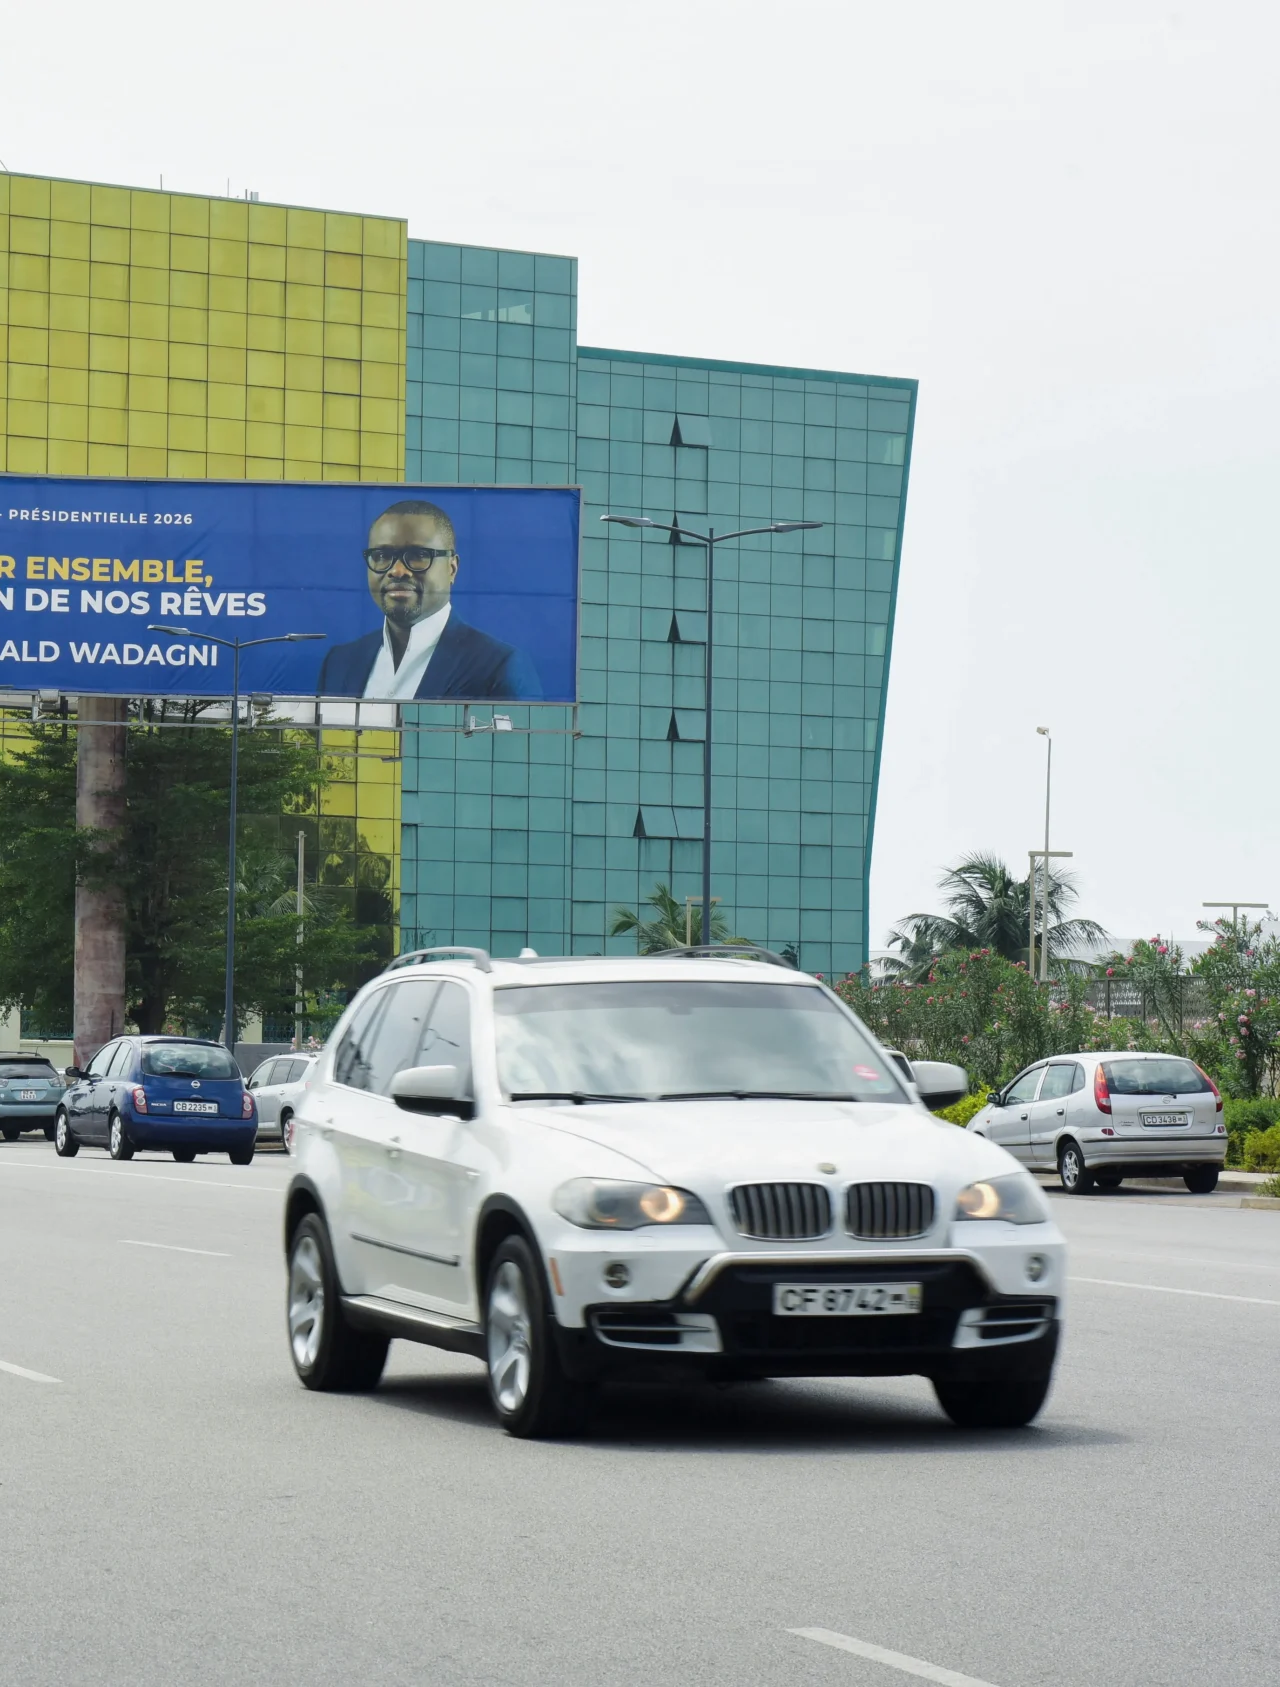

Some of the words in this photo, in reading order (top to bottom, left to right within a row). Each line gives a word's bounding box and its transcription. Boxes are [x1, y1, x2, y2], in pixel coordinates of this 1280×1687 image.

[9, 507, 148, 524] PRÉSIDENTIELLE
[153, 513, 193, 525] 2026
[26, 556, 213, 588] ENSEMBLE,
[25, 587, 70, 613] DE
[80, 589, 151, 615] NOS
[160, 586, 267, 617] RÊVES
[69, 641, 218, 667] WADAGNI
